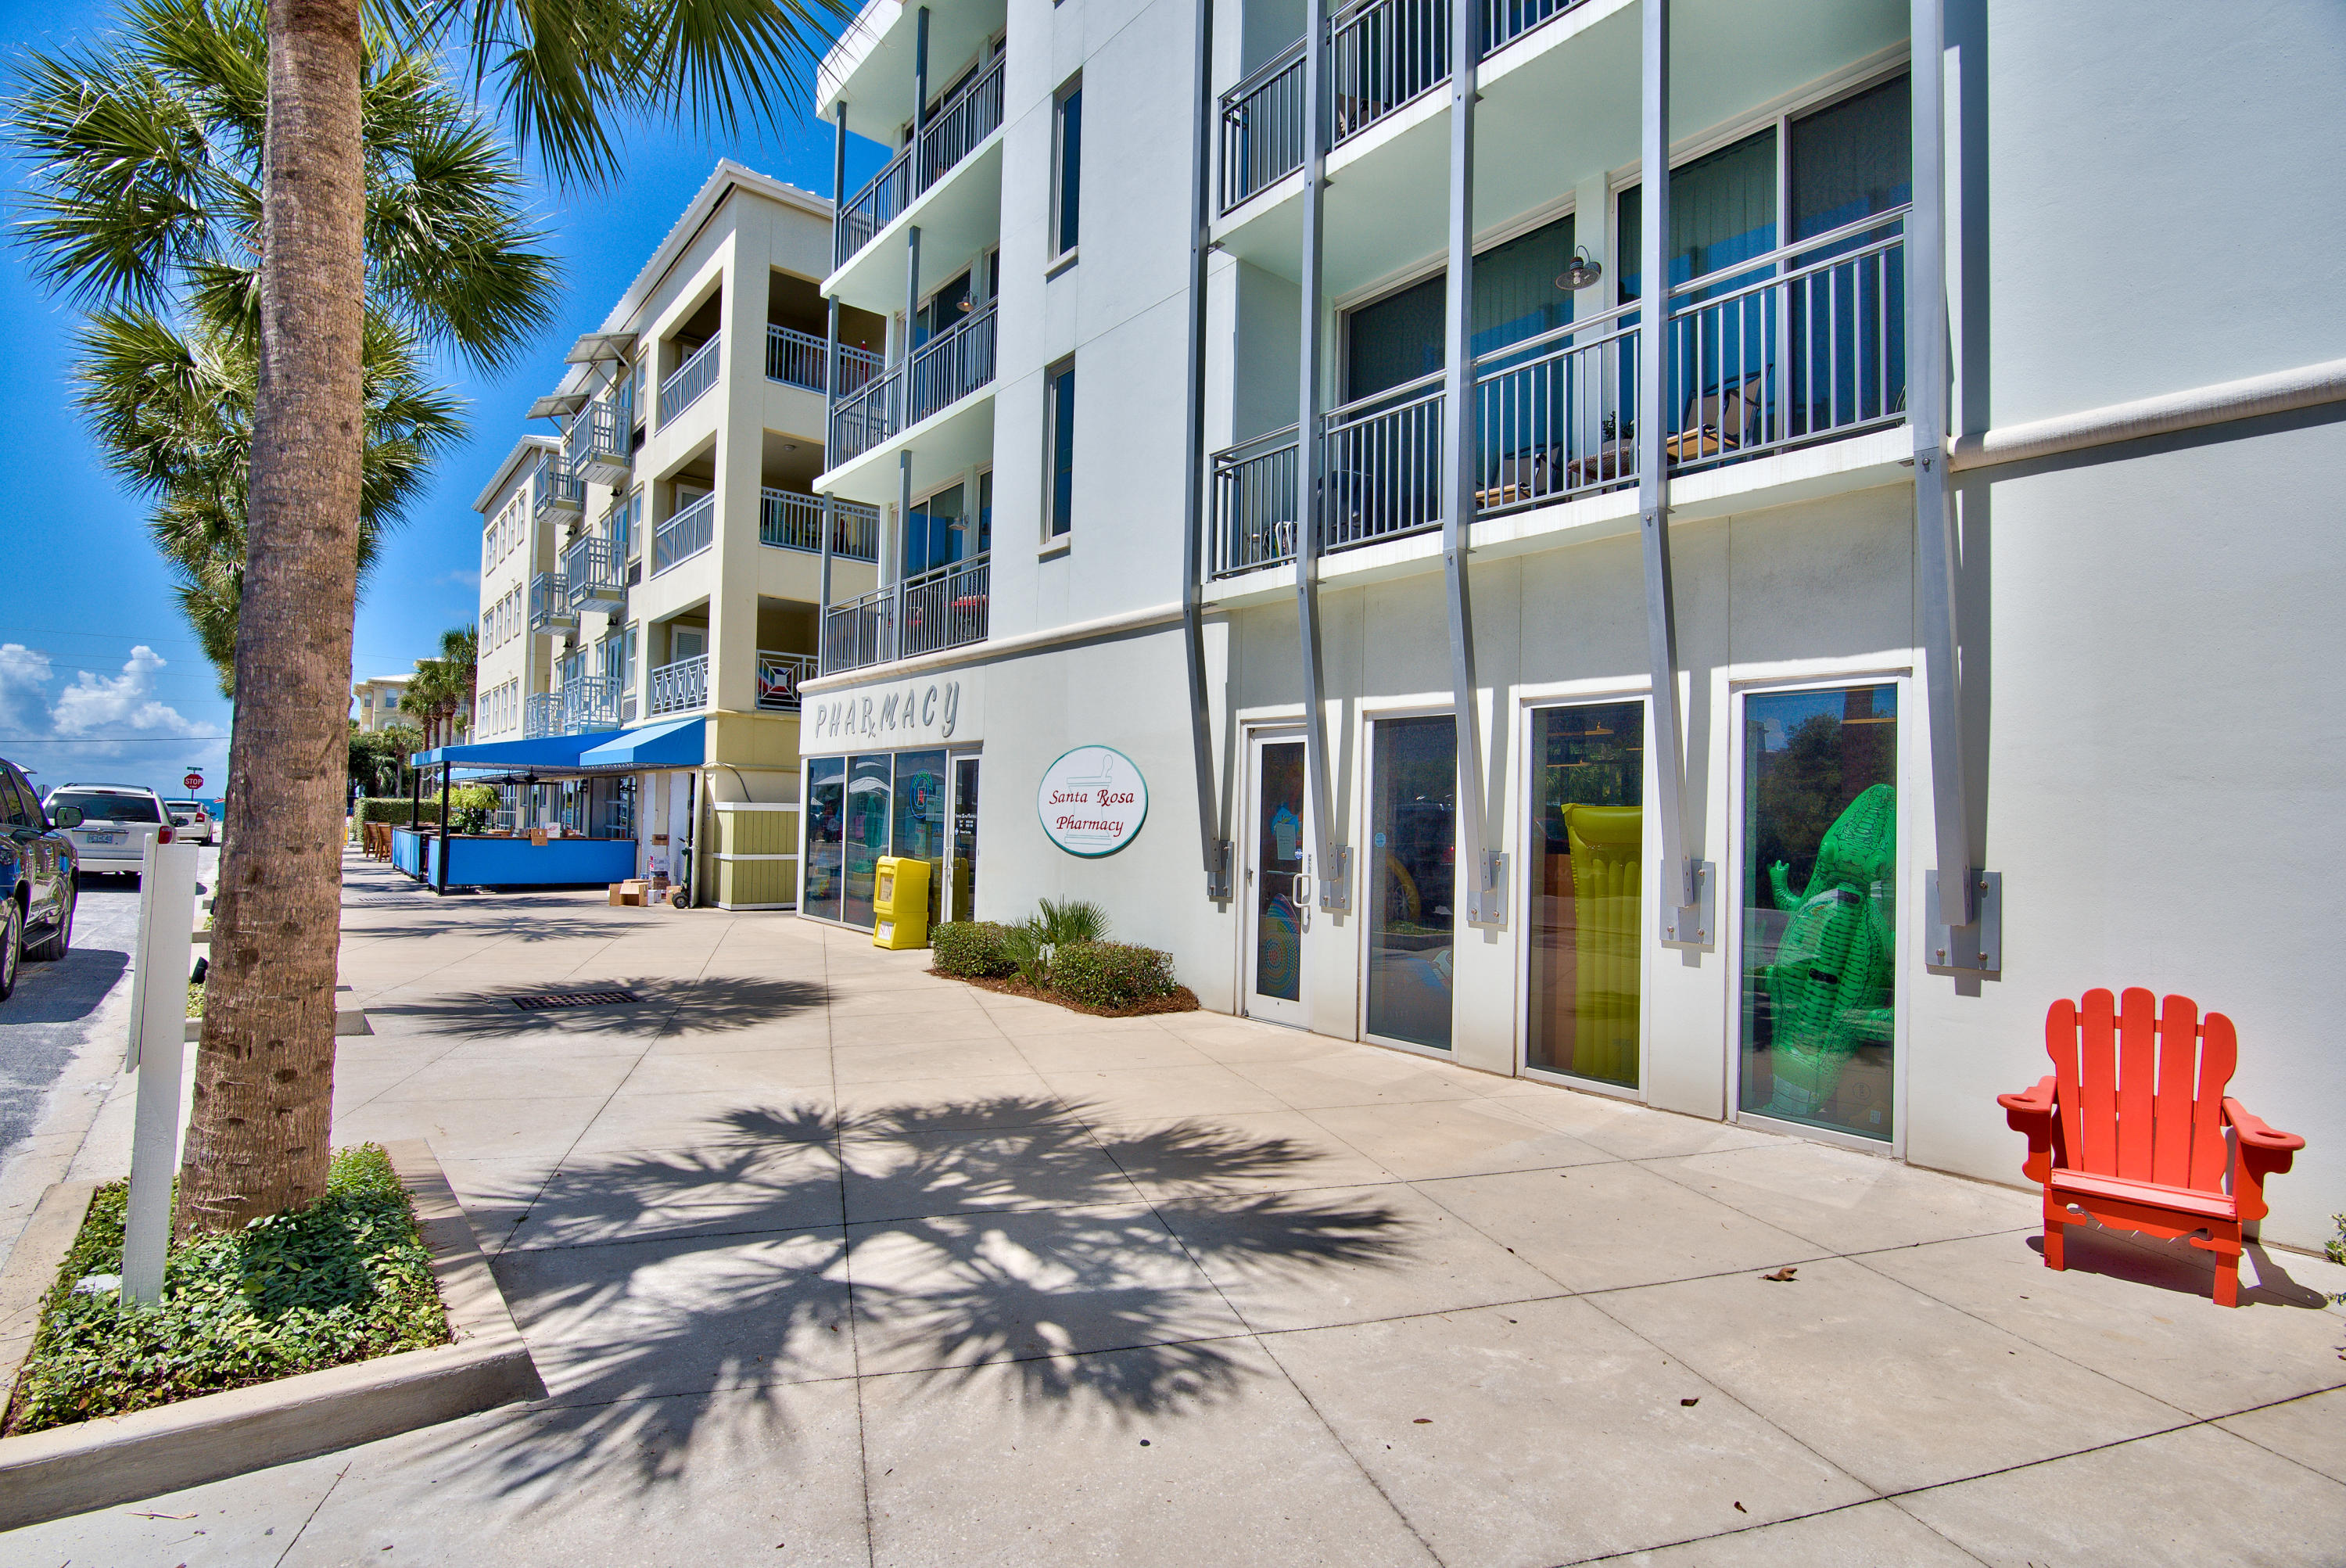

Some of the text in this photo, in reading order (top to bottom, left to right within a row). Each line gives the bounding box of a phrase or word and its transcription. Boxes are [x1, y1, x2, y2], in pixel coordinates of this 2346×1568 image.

[815, 681, 960, 739] PHARMACY
[1049, 789, 1135, 807] Santa Rosa
[1056, 815, 1125, 838] Pharmacy
